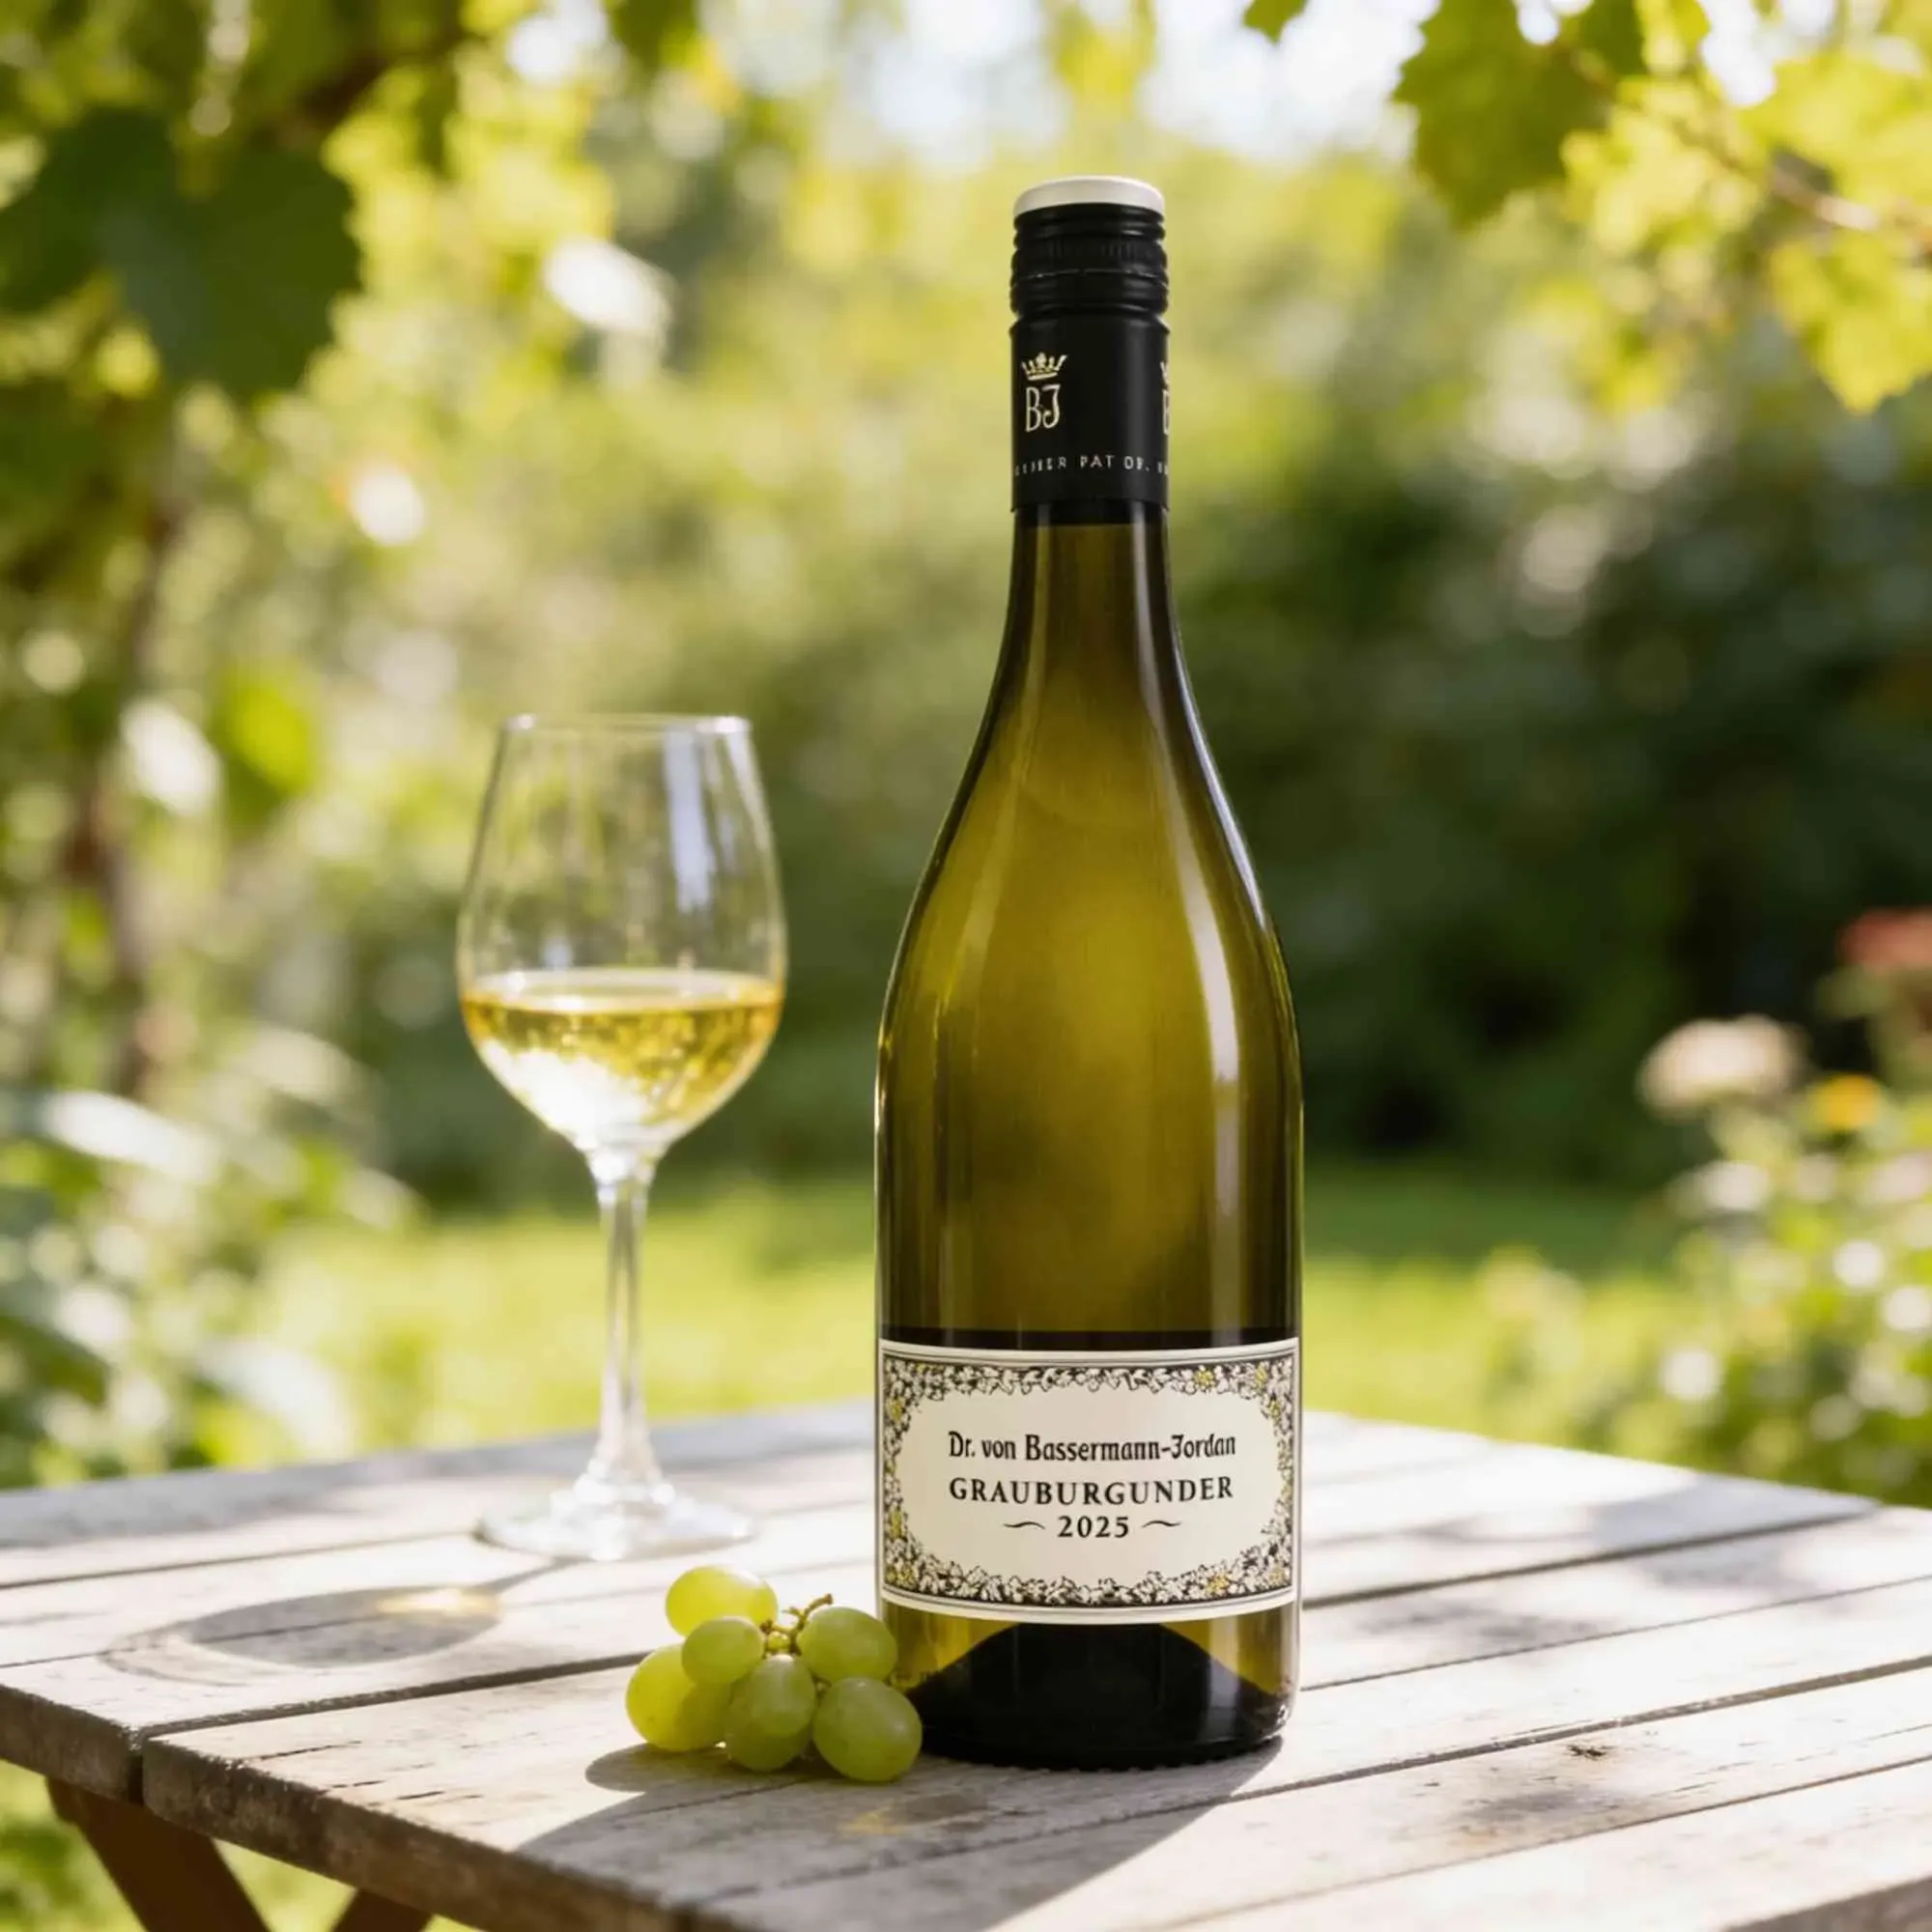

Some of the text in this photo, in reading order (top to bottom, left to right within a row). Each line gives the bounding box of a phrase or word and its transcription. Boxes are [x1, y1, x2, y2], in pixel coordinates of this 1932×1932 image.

[948, 1431, 1236, 1462] Dr. von Bassermann-Jordan
[950, 1476, 1232, 1505] GRAUBURGUNDER
[1058, 1516, 1129, 1539] 2025
